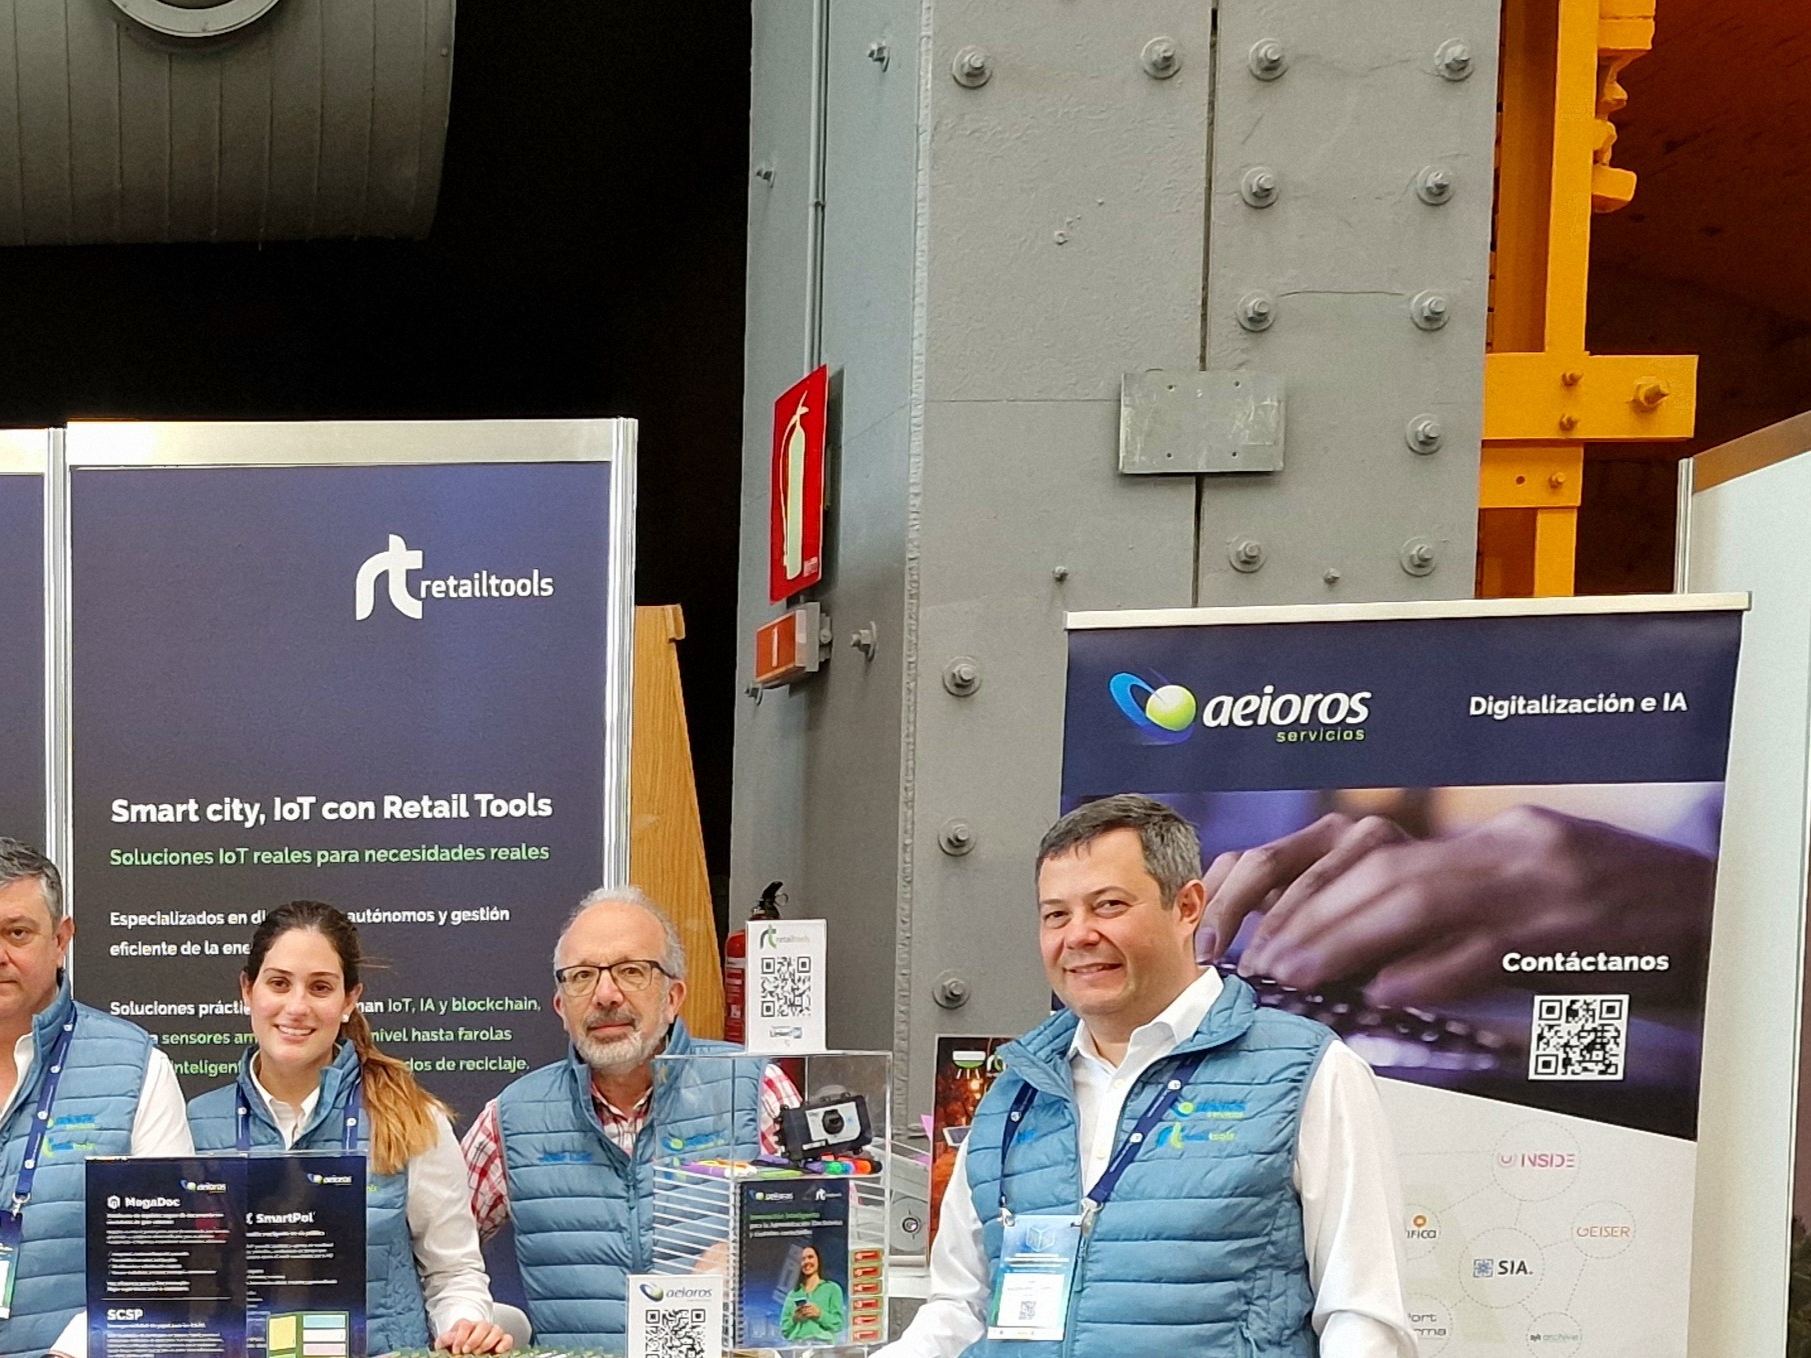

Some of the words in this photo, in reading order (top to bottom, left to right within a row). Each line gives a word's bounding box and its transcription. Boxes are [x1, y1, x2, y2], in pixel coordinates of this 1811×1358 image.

[420, 569, 554, 599] retailtools
[1203, 685, 1372, 728] aeioros
[1469, 693, 1635, 720] Digitalización
[1641, 698, 1657, 713] e
[1662, 693, 1688, 712] IA
[1276, 727, 1365, 743] servicios
[111, 797, 199, 824] Smart
[206, 798, 266, 828] city,
[274, 796, 316, 821] IoT
[322, 801, 375, 820] con
[384, 794, 469, 819] Retail
[474, 792, 553, 818] Tools
[110, 847, 214, 867] Soluciones
[219, 848, 249, 865] IoT
[252, 847, 312, 864] reales
[317, 849, 360, 867] para
[364, 845, 486, 864] necesidades
[490, 844, 550, 861] reales
[110, 910, 225, 928] Especializados
[228, 914, 247, 925] en
[439, 911, 449, 925] y
[451, 907, 510, 925] gestión
[110, 941, 177, 956] eficiente
[181, 941, 201, 956] de
[204, 941, 219, 956] la
[1502, 951, 1670, 973] Contáctanos
[110, 1000, 195, 1015] Soluciones
[420, 997, 435, 1011] IA
[439, 1000, 448, 1015] y
[452, 996, 541, 1012] blockchain,
[162, 1033, 230, 1044] sensores
[371, 1027, 407, 1042] nivel
[411, 1027, 454, 1042] hasta
[458, 1026, 512, 1042] farolas
[436, 1057, 455, 1071] de
[459, 1055, 530, 1072] reciclaje.
[1521, 1153, 1575, 1168] INSIDE
[1576, 1226, 1630, 1238] GEISER
[107, 1308, 143, 1320] SCSP
